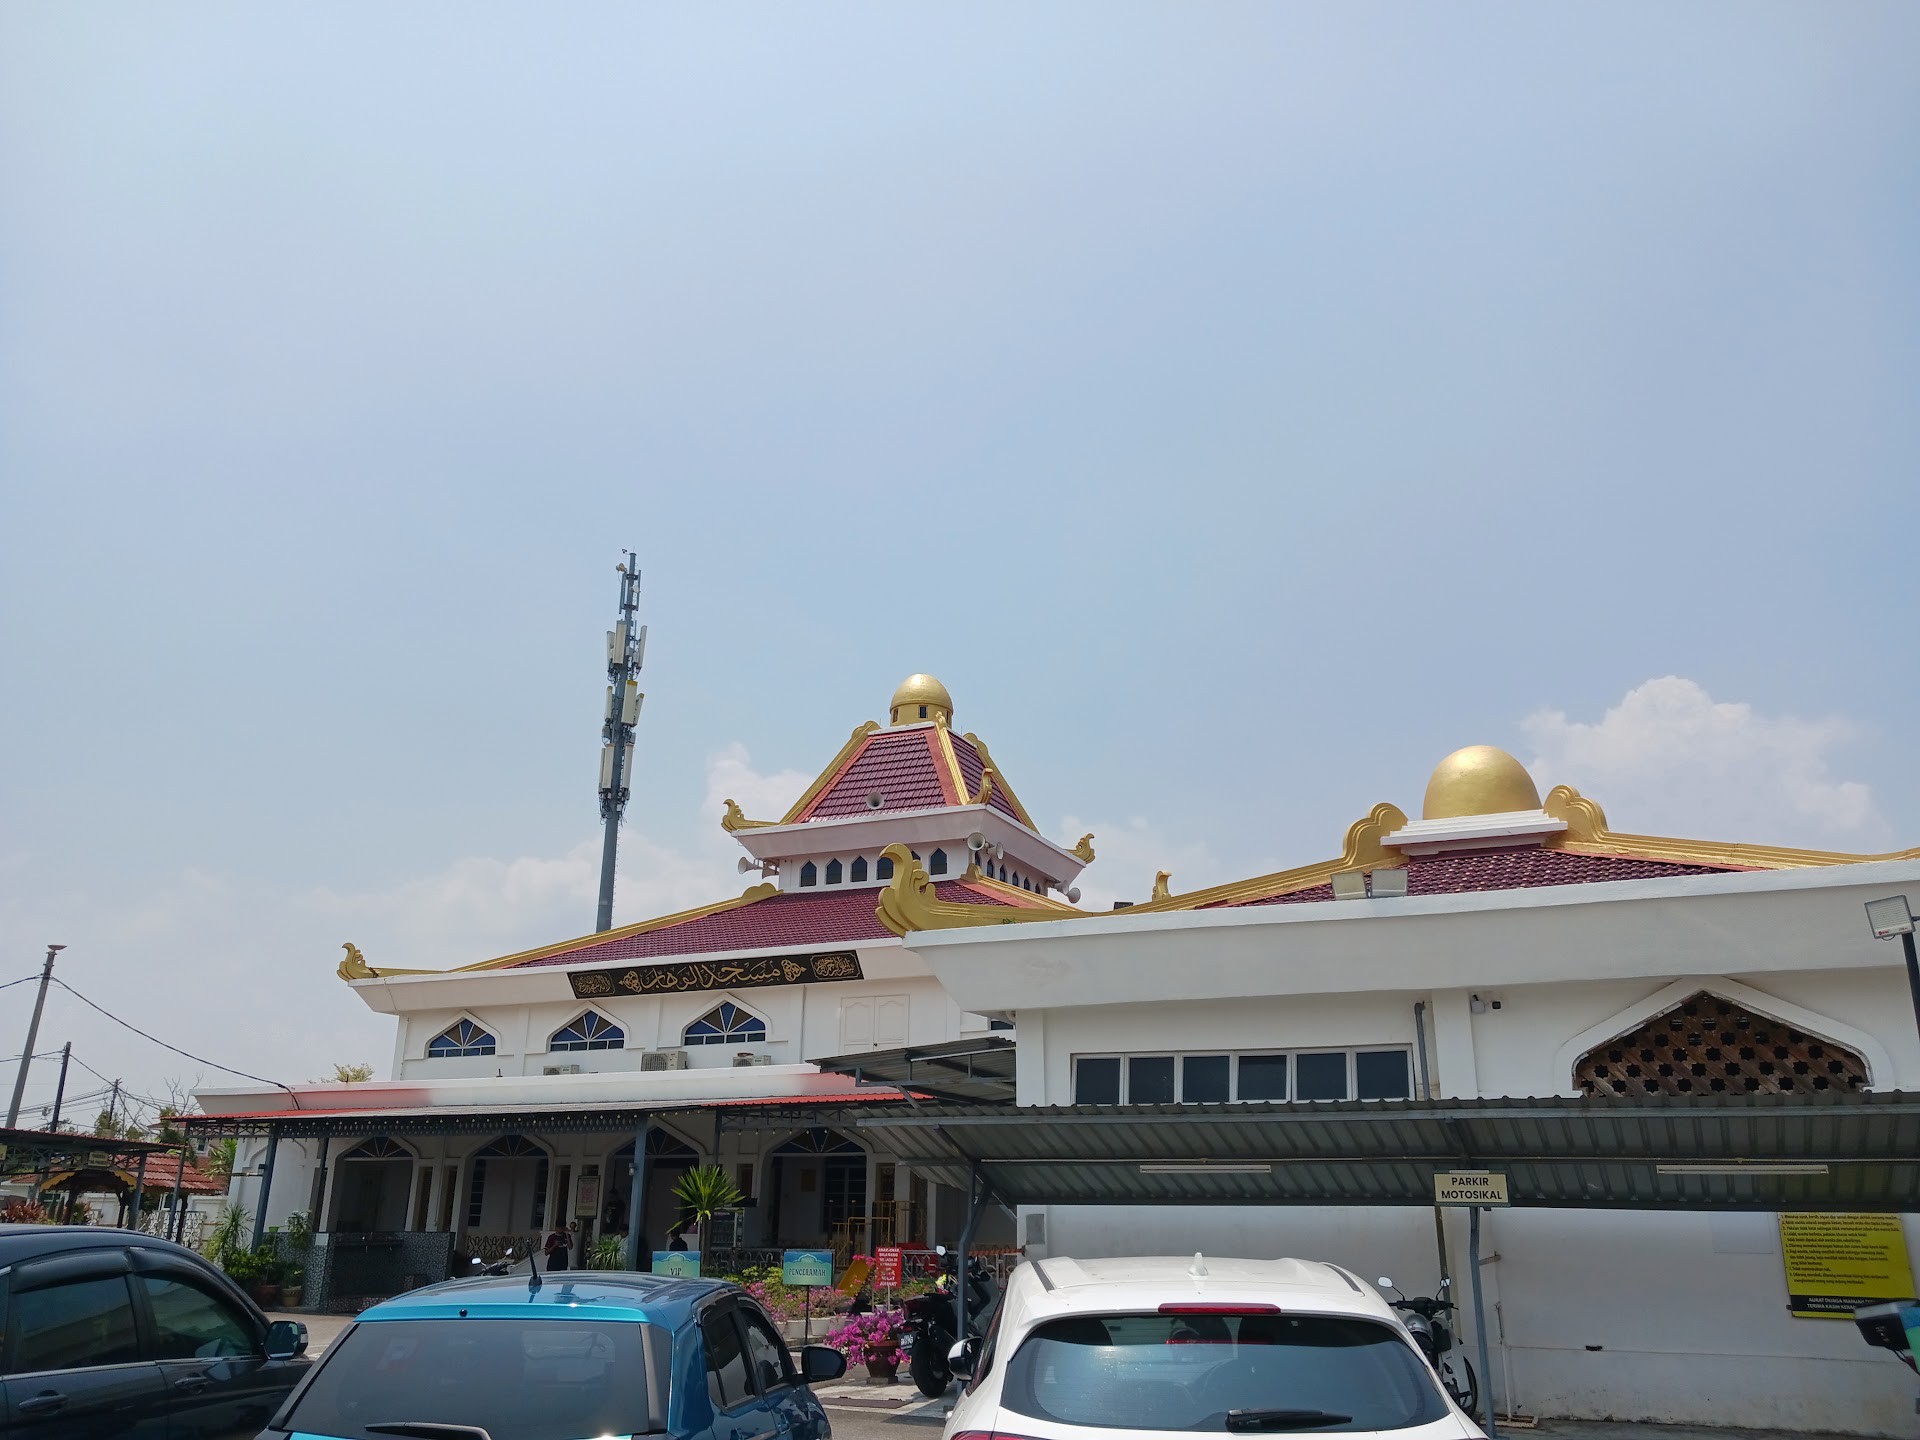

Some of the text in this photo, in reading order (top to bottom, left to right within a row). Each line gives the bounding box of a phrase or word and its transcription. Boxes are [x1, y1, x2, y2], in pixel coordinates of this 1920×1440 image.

[640, 964, 703, 990] الوهاب
[701, 960, 781, 988] مسجد
[1451, 1177, 1489, 1186] PARKIR
[1441, 1190, 1503, 1200] MOTOSIKAL
[670, 1267, 682, 1276] VIP
[788, 1267, 826, 1277] PENCERAMAH
